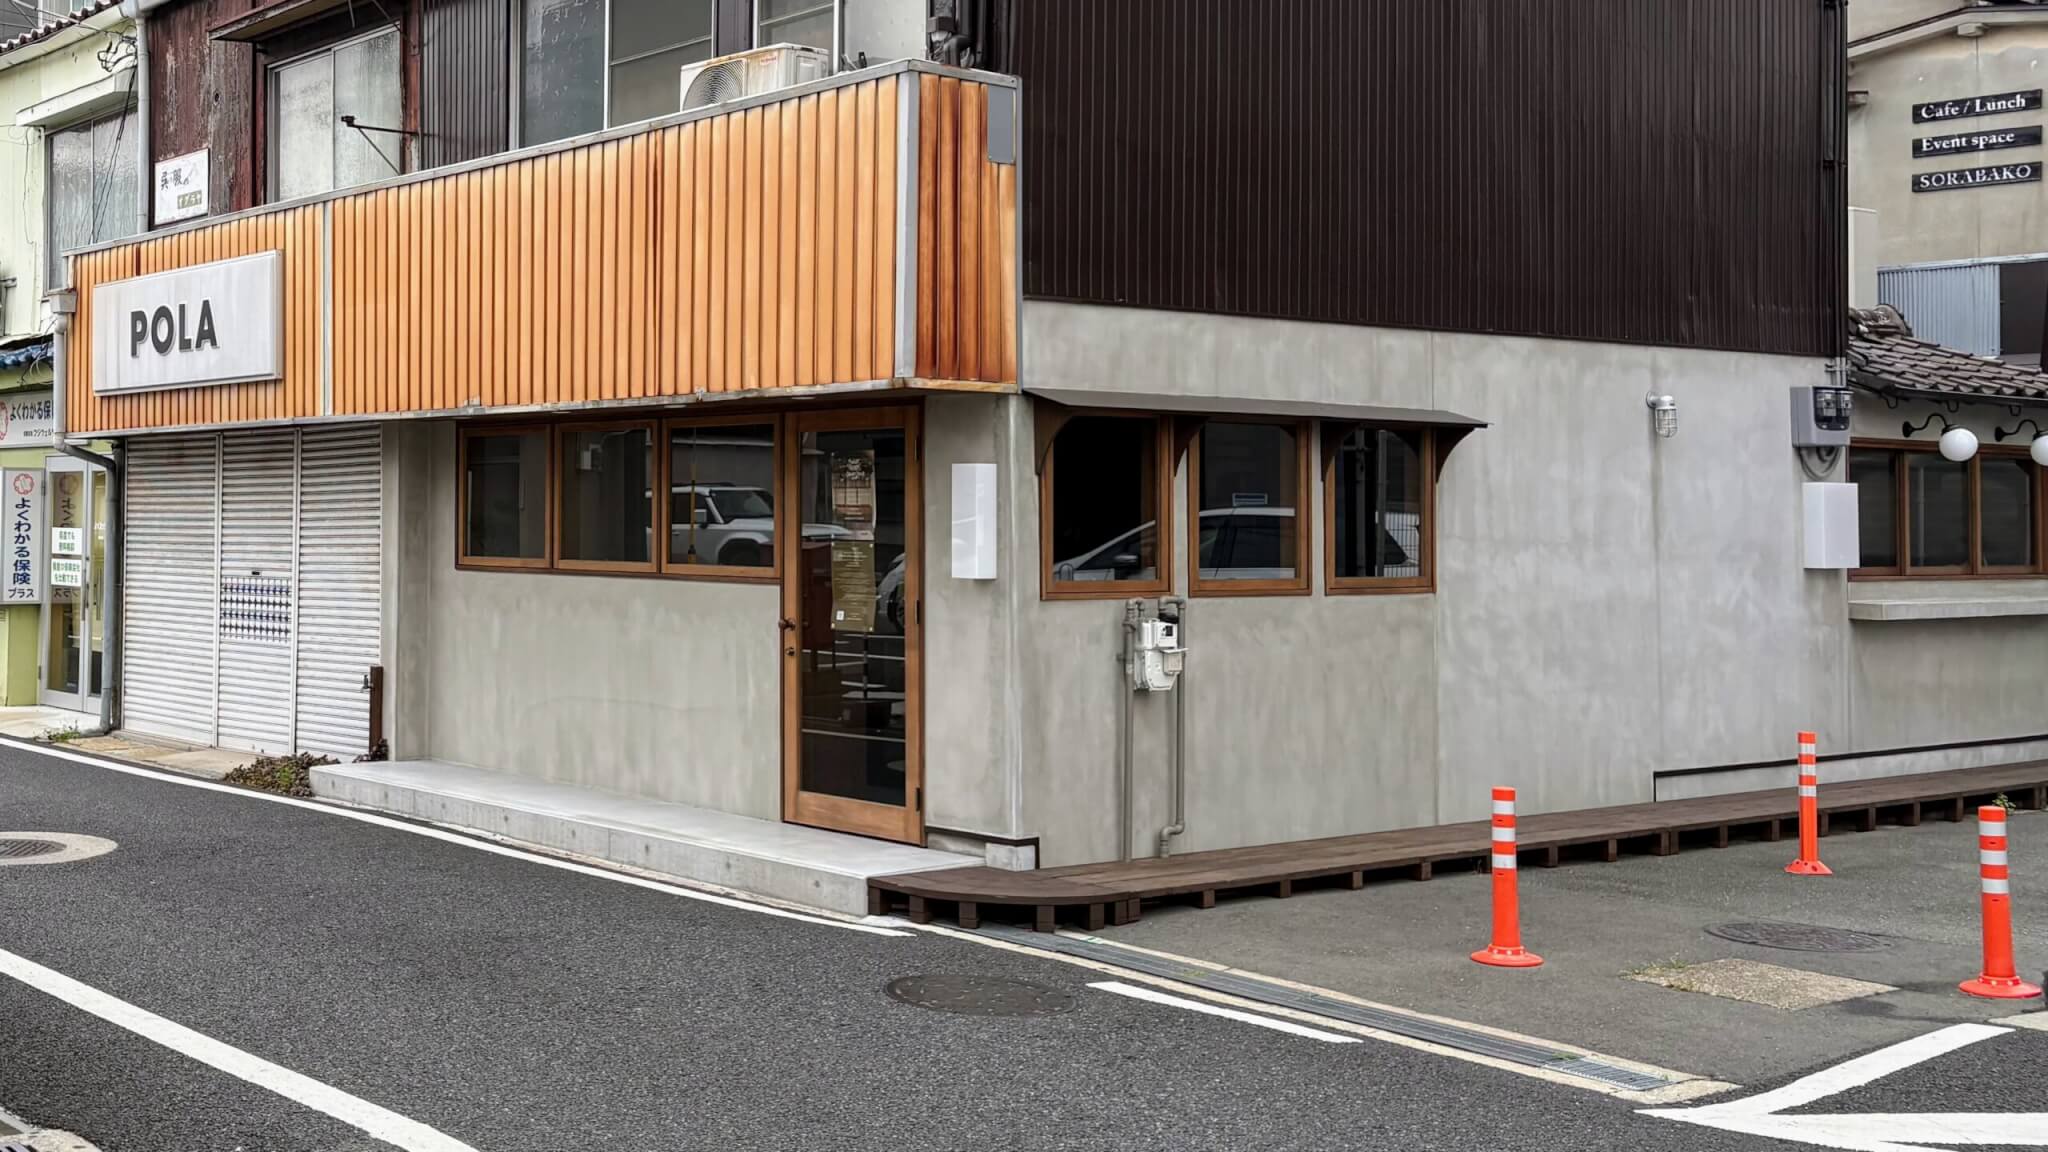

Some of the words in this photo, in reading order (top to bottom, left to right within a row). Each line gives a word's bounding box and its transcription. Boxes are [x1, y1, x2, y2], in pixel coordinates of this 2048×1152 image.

[1921, 102, 1960, 119] Cafe
[1974, 94, 2026, 113] Lunch
[1921, 137, 1968, 151] Event
[1971, 132, 2015, 149] space
[1920, 164, 2032, 188] SORABAKO
[130, 299, 219, 358] POLA
[10, 400, 54, 421] よくわかる保
[13, 497, 32, 586] よくわかる保険
[8, 588, 35, 599] プラス
